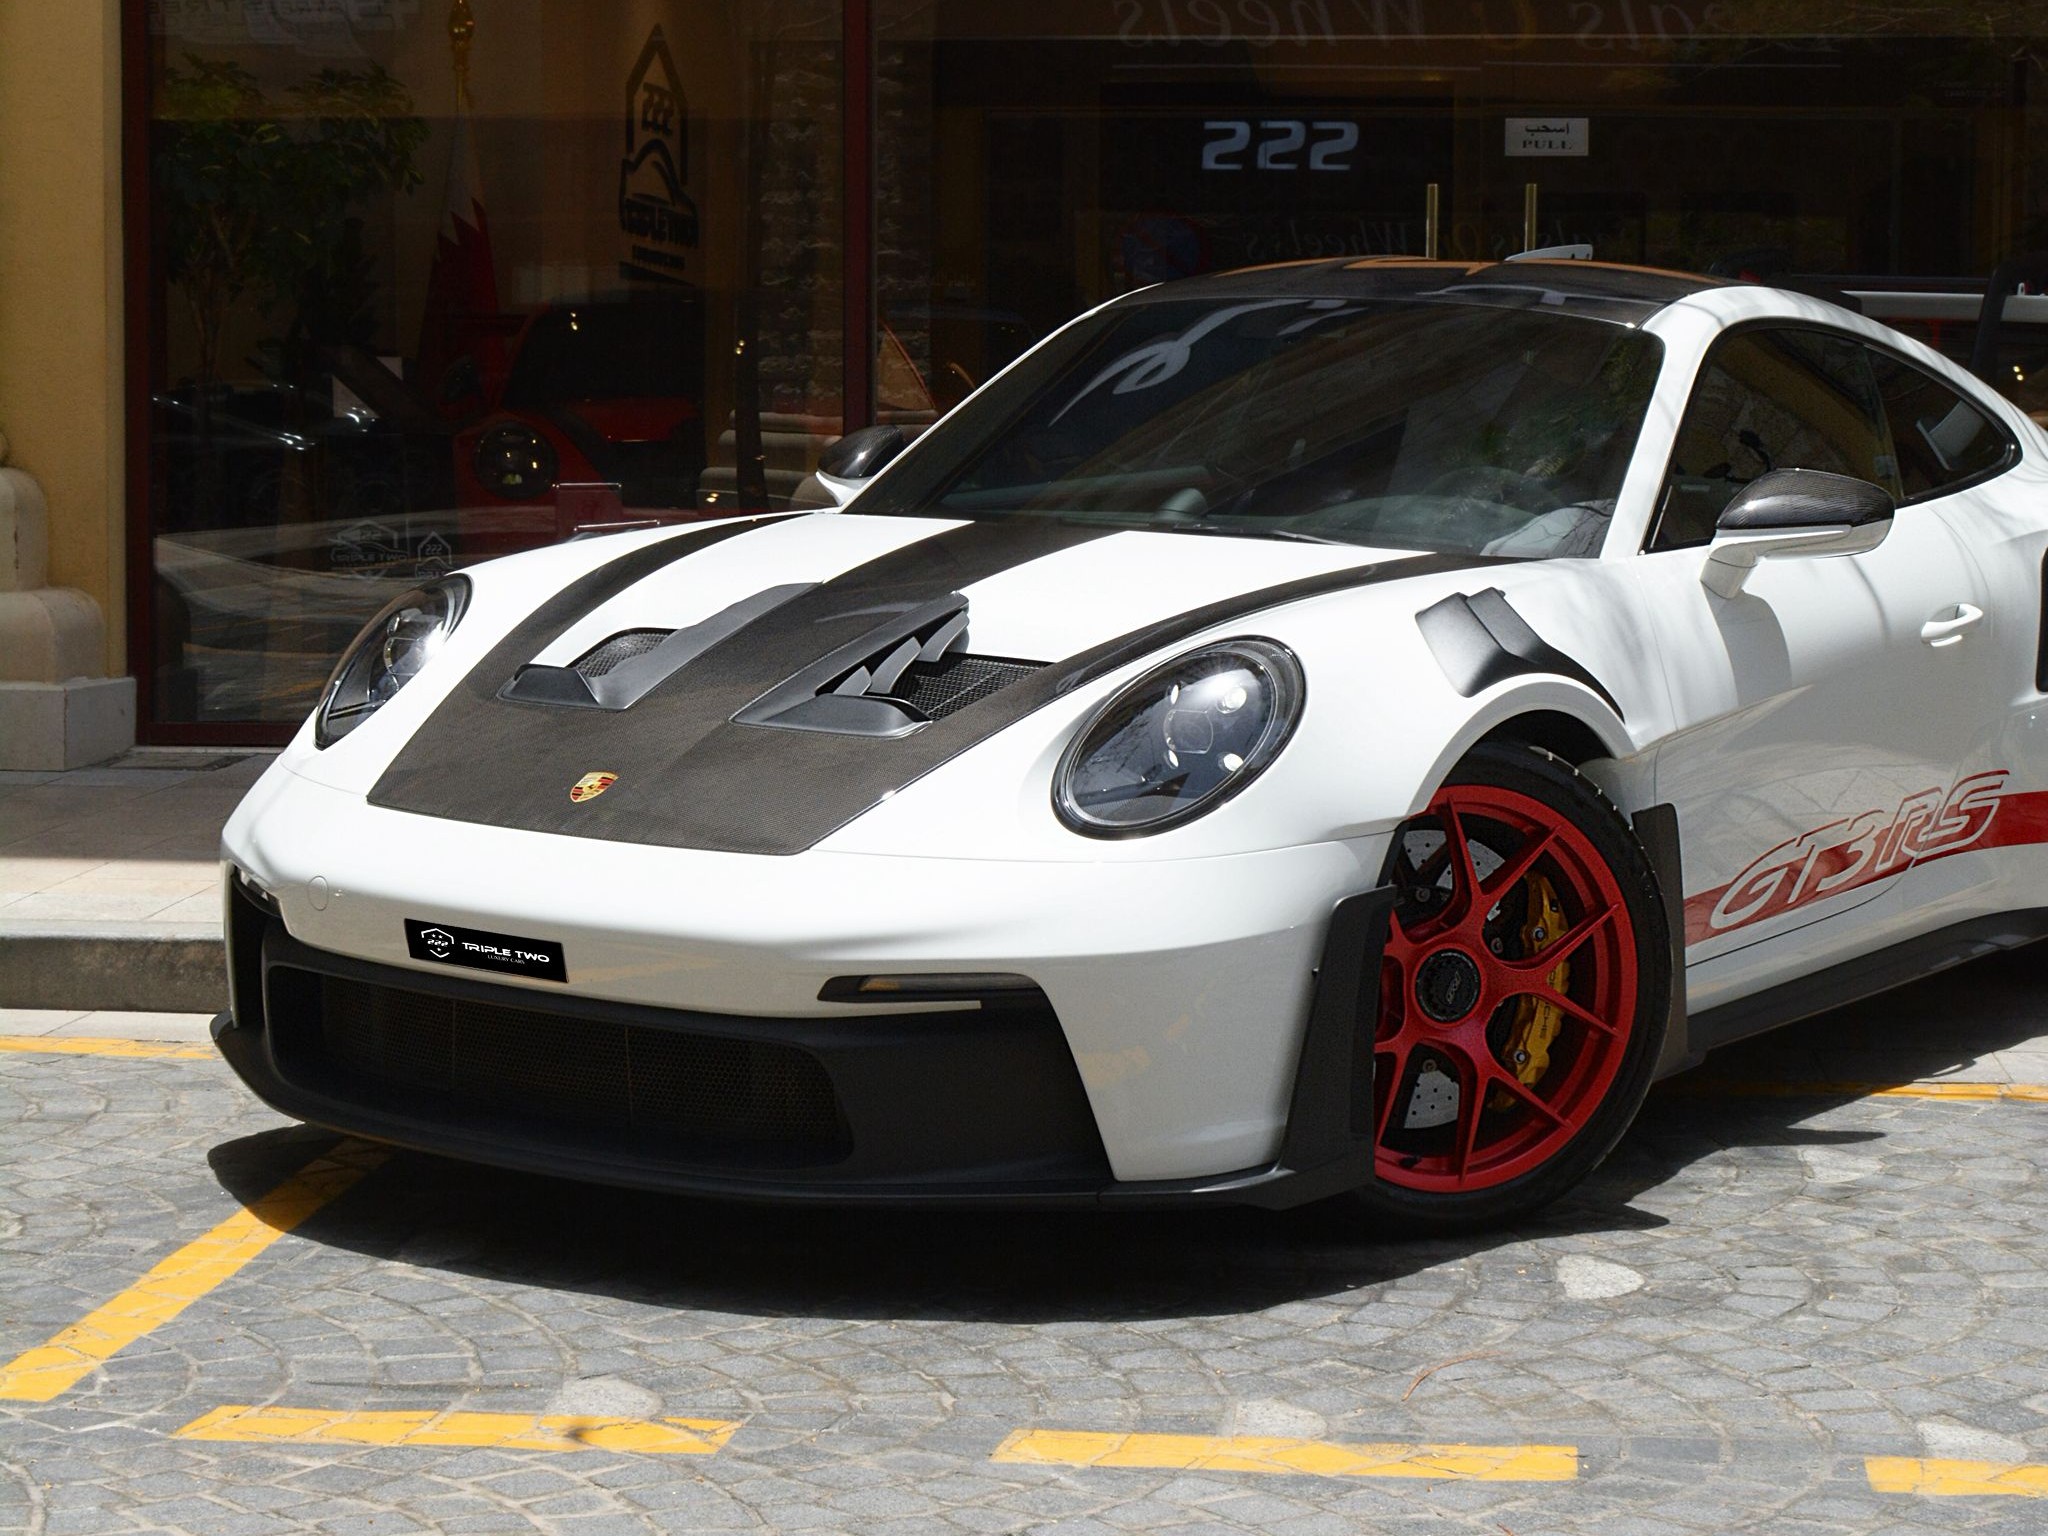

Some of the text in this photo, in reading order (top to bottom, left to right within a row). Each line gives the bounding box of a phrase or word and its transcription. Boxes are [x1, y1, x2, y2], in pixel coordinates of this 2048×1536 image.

[1522, 140, 1573, 150] PULL
[461, 941, 551, 964] TRIPLE TWO
